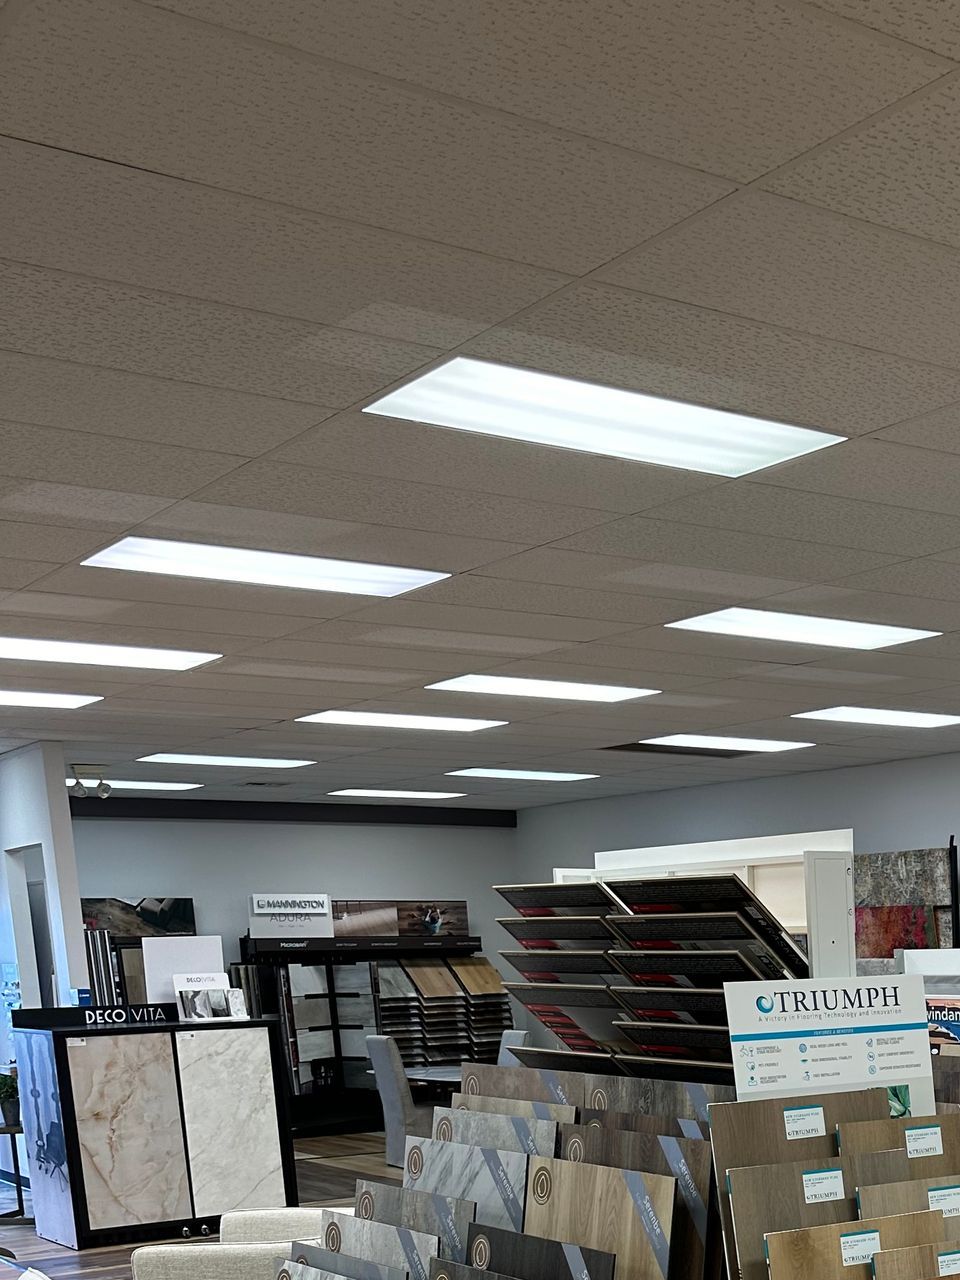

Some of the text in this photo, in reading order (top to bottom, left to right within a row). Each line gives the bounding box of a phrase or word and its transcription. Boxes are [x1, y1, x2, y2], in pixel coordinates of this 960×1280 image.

[267, 900, 325, 909] MANNINGTON
[270, 913, 312, 922] ADURA
[774, 986, 901, 1013] TRIUMPH
[85, 1007, 167, 1025] DECO VITA
[765, 1014, 787, 1022] Victory
[797, 1012, 822, 1020] Flooring
[824, 1010, 857, 1019] Technology
[498, 1166, 514, 1200] Serenbe
[679, 1159, 697, 1197] Serenbe
[643, 1195, 661, 1236] Serenbe
[943, 1207, 960, 1215] UMPH
[848, 1253, 871, 1262] TRIUMP
